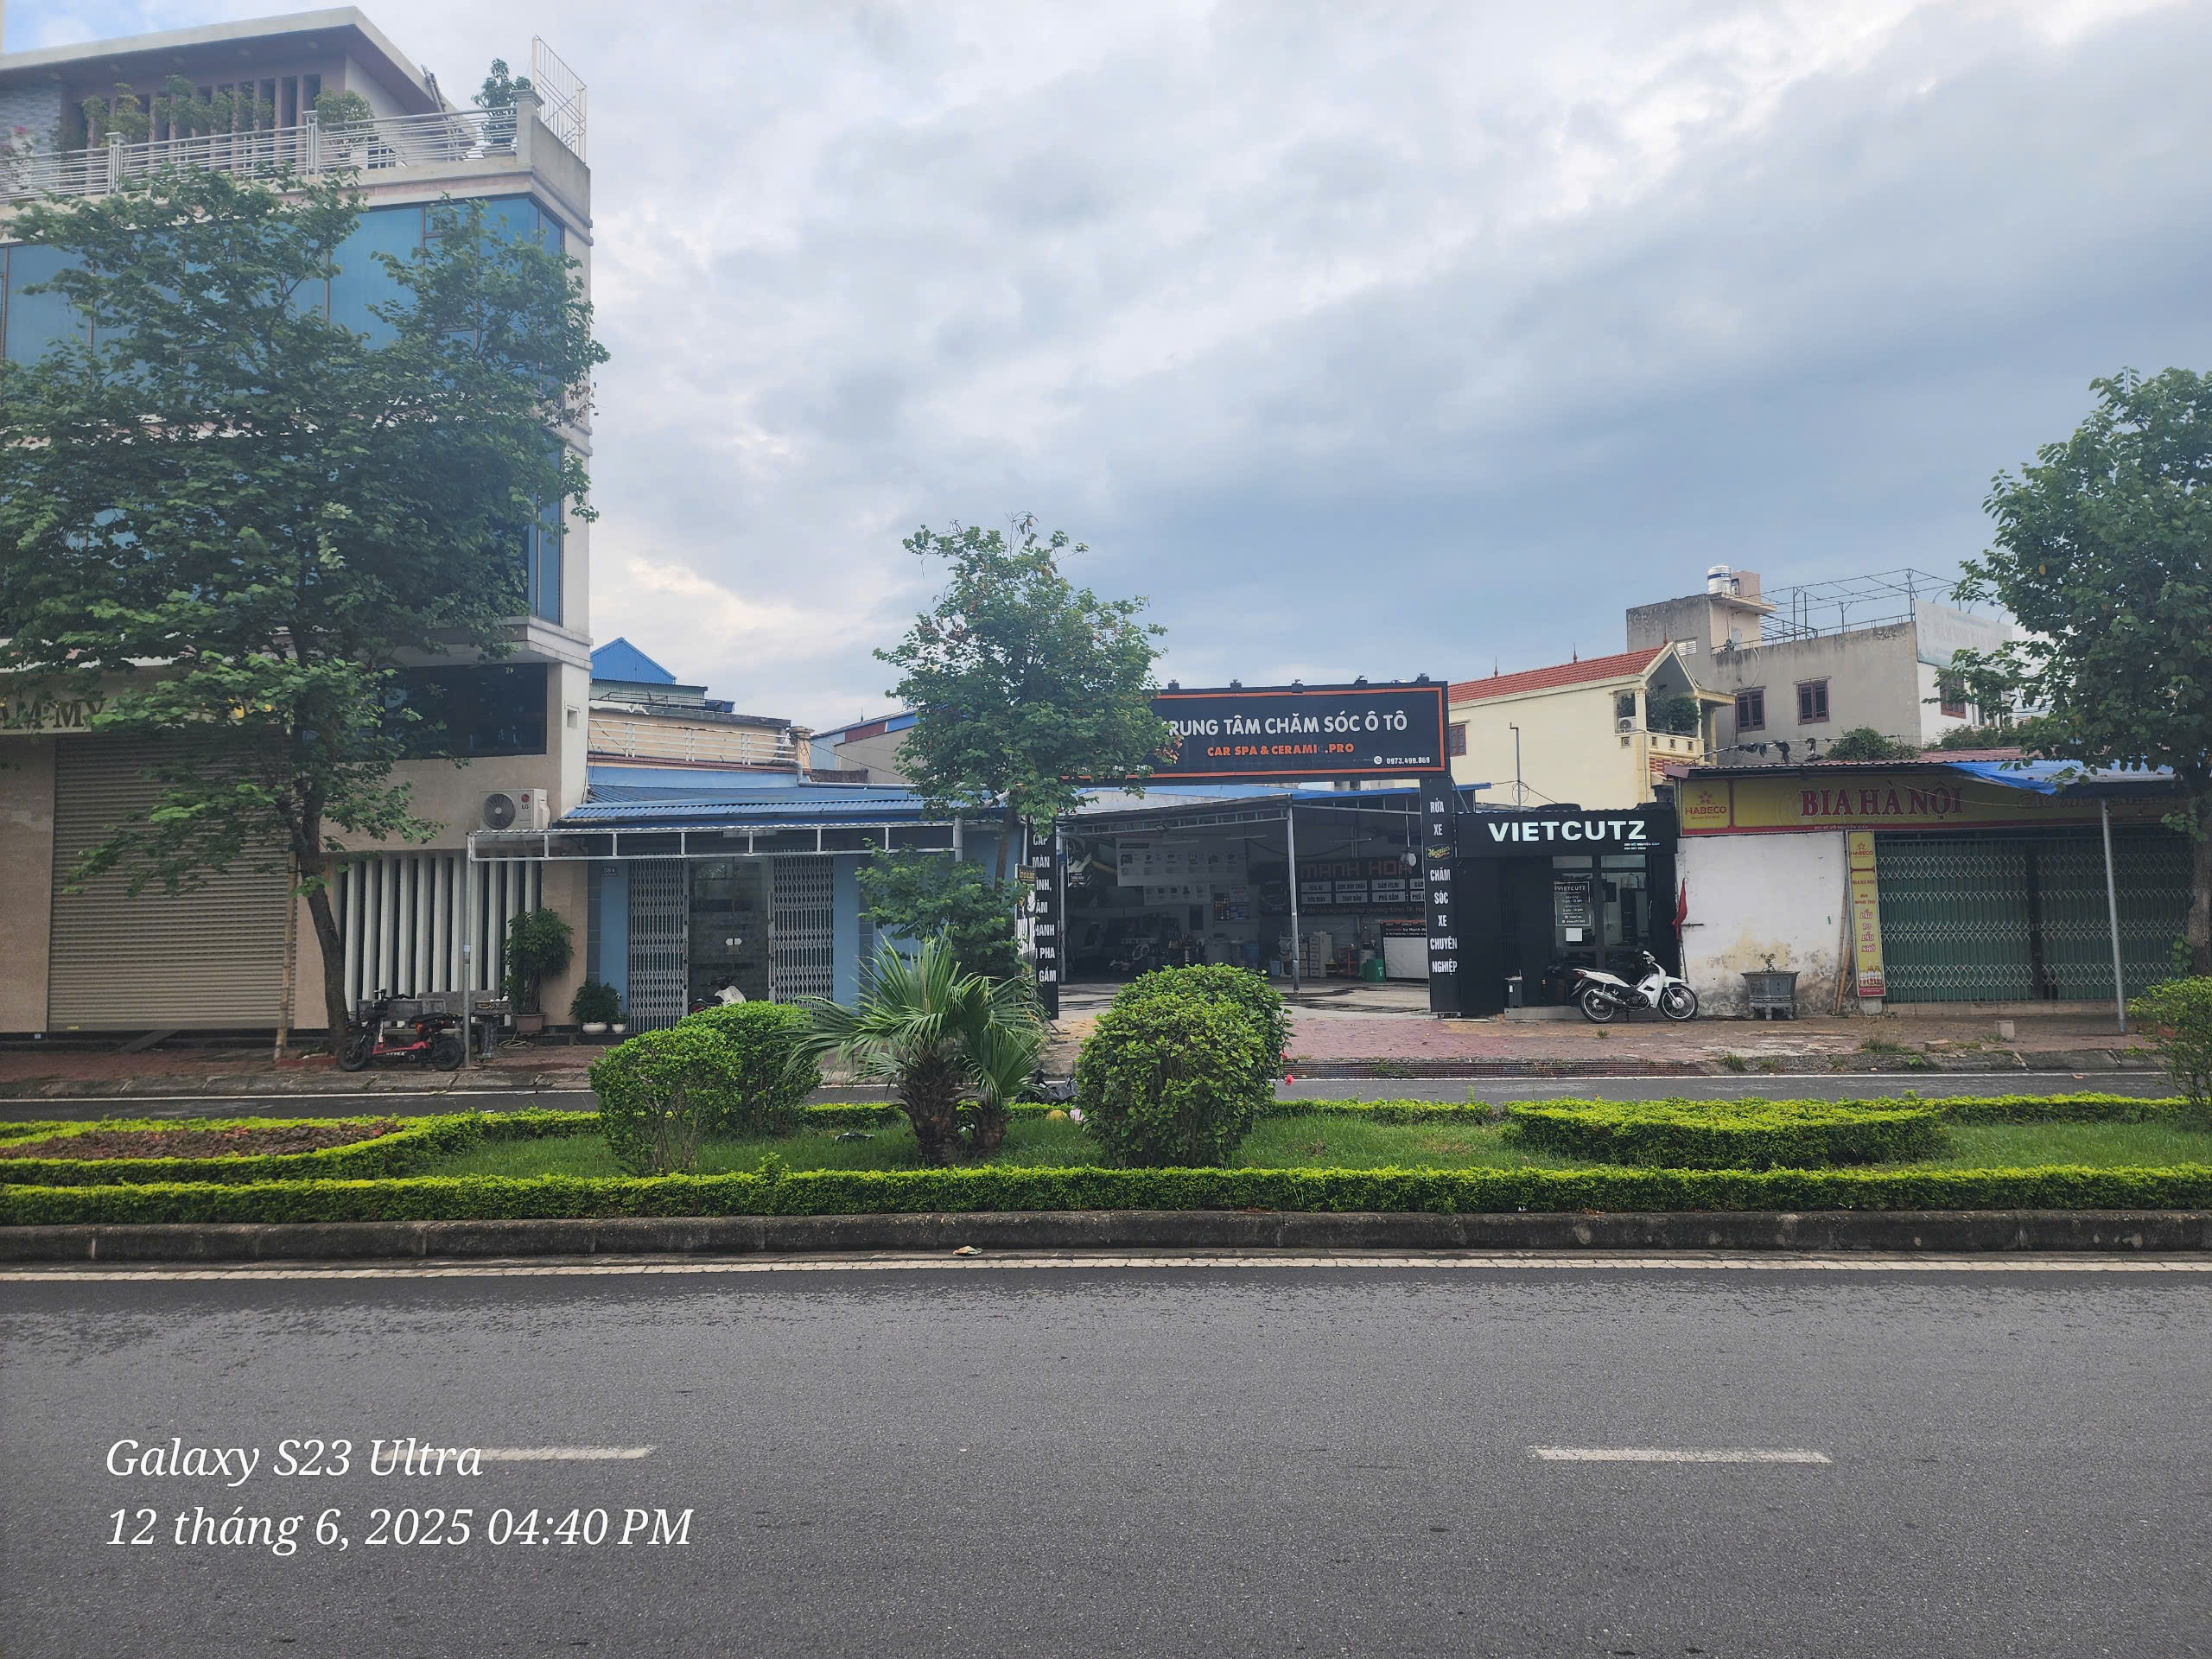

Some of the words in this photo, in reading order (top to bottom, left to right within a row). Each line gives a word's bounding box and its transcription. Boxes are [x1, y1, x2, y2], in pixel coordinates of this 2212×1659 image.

[1223, 715, 1261, 734] TÂM
[1264, 713, 1319, 734] CHĂM
[1324, 710, 1360, 733] SÓC
[1364, 710, 1379, 732] Ô
[1382, 710, 1408, 731] TÔ
[1207, 747, 1230, 757] CAR
[1234, 746, 1257, 755] SPA
[1260, 745, 1269, 755] &
[1430, 798, 1445, 813] RỬA
[1800, 788, 1853, 817] BIA
[1858, 779, 1904, 817] HÀ
[1908, 781, 1964, 821] NỘI
[1685, 806, 1726, 816] HABECO
[1433, 823, 1443, 836] XE
[1487, 820, 1647, 842] VIETCUTZ
[1033, 855, 1050, 868] MÀN
[1430, 867, 1451, 881] CHĂM
[1036, 877, 1052, 892] ÌNH,
[1434, 890, 1448, 905] SÓC
[1036, 899, 1048, 913] ÂM
[1438, 915, 1447, 927] XE
[1036, 925, 1055, 936] HANH
[1430, 936, 1458, 950] CHUYÊN
[1039, 947, 1055, 959] PHA
[1432, 958, 1458, 975] NGHIỆP
